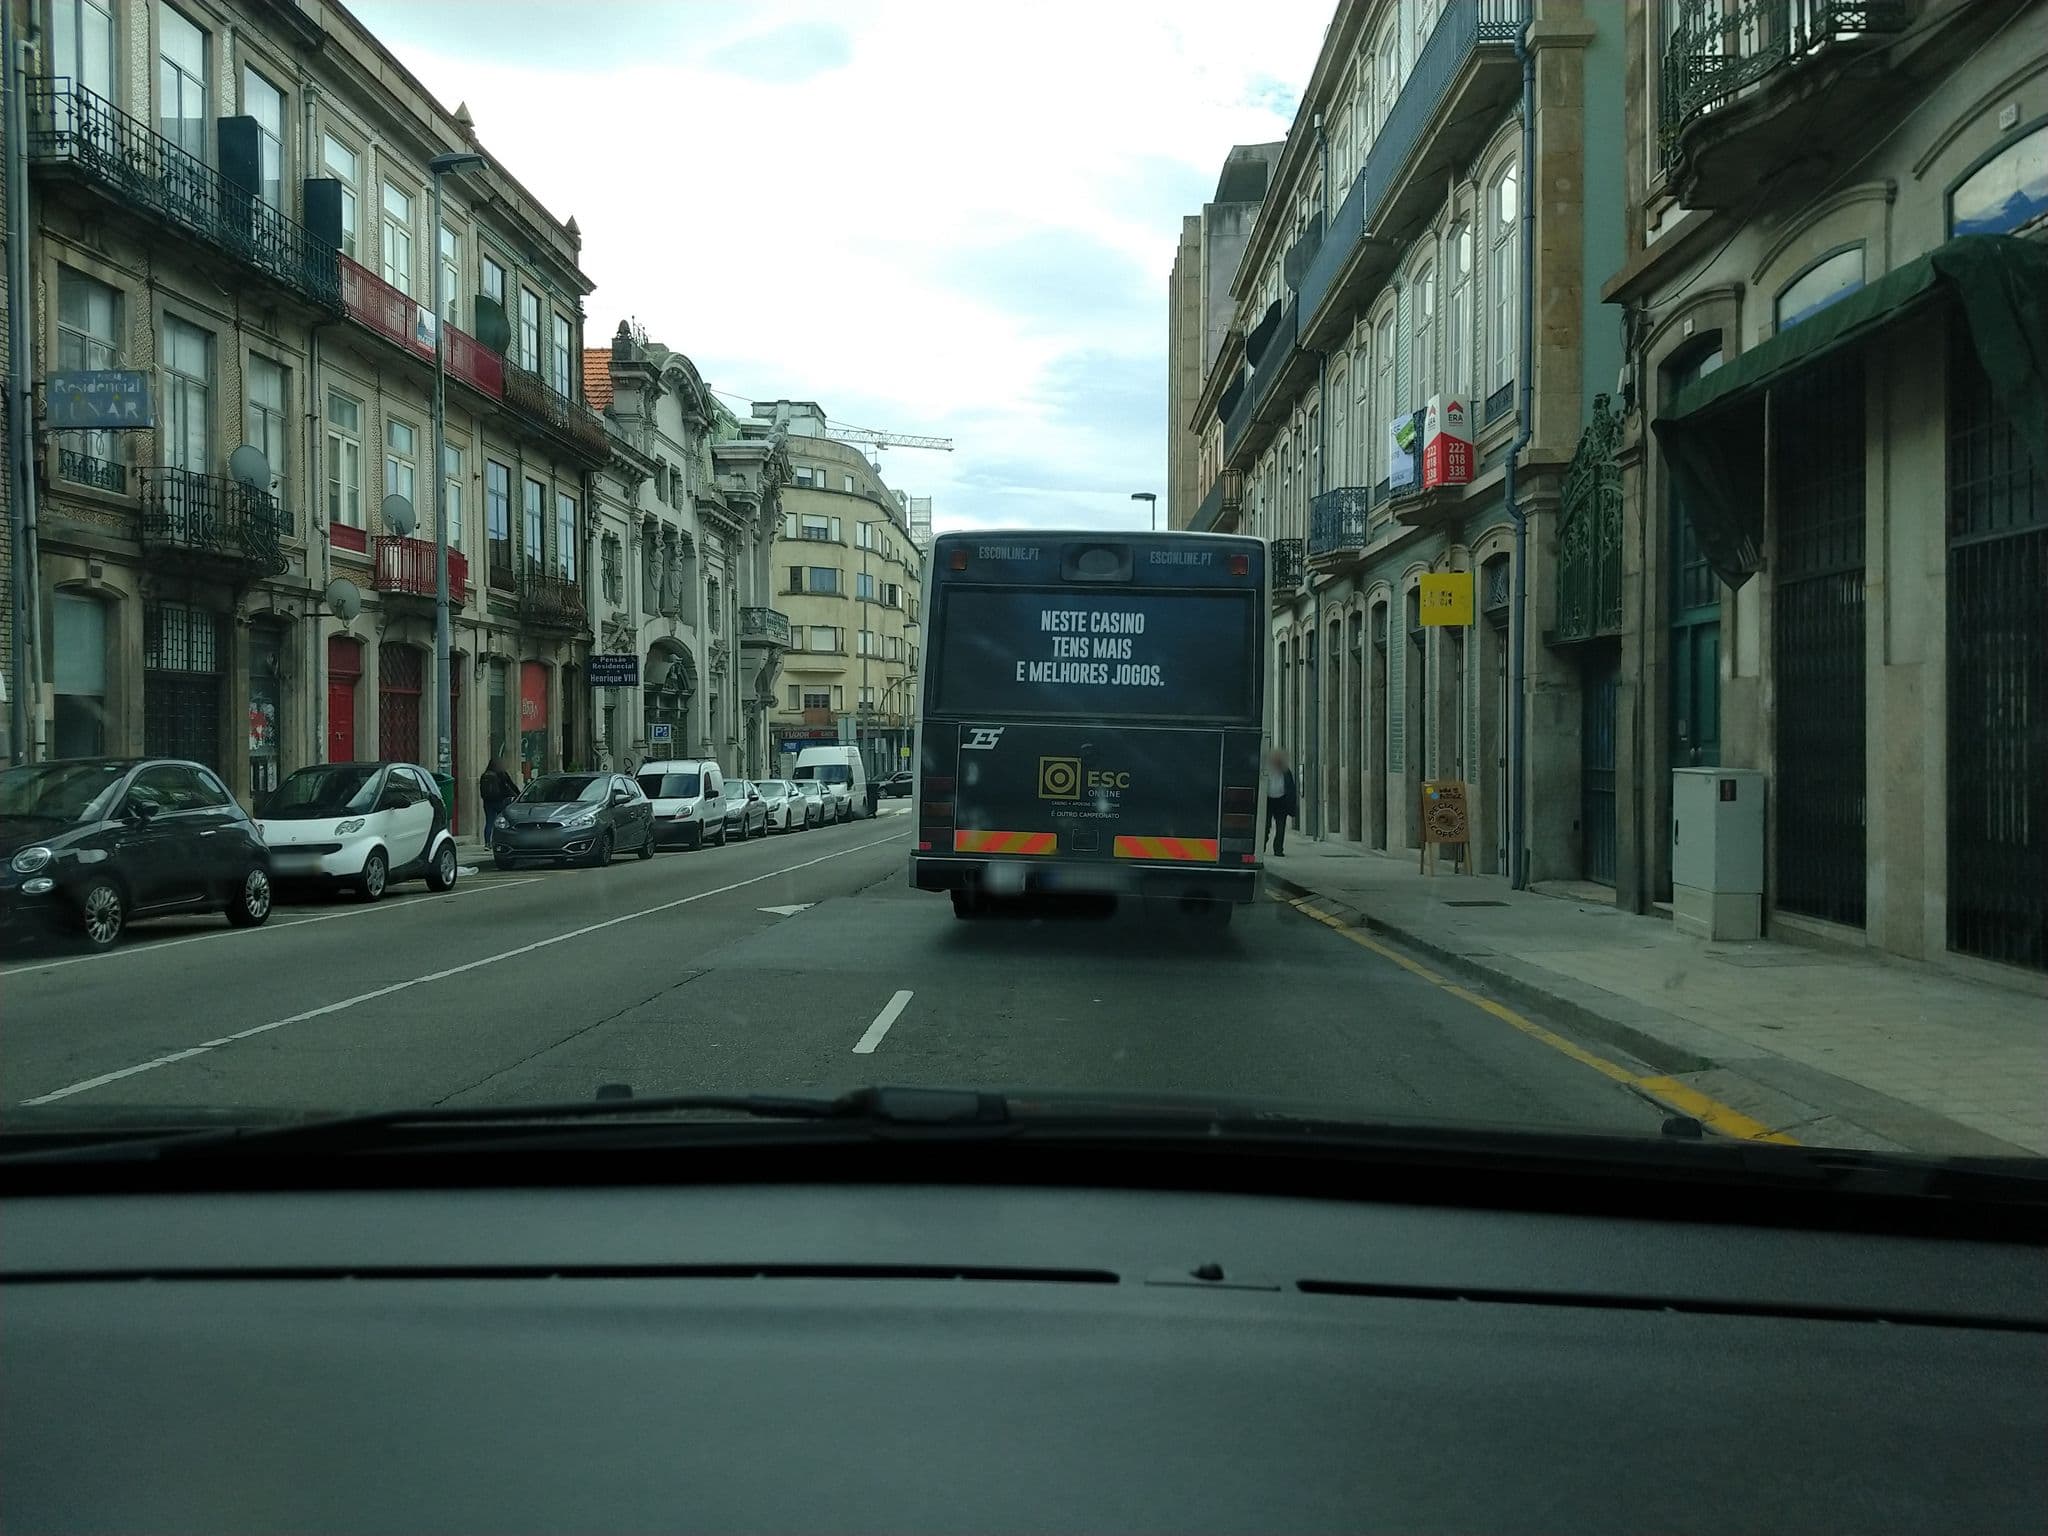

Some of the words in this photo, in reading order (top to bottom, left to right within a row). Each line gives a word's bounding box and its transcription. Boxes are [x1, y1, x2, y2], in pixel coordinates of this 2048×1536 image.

[55, 378, 140, 393] Residencial
[1448, 414, 1464, 422] ERA
[1448, 443, 1465, 454] 222
[1448, 454, 1466, 465] 018
[1449, 465, 1466, 477] 338
[979, 546, 1040, 561] ESCONLINE.PT
[1041, 610, 1087, 633] NESTE
[1090, 611, 1145, 634] CASINO
[1052, 636, 1089, 658] TENS
[1093, 638, 1132, 660] MAIS
[592, 662, 634, 670] Residencial
[590, 674, 622, 684] Henrique
[623, 674, 636, 682] VIII
[1016, 661, 1026, 682] E
[1029, 661, 1108, 685] MELHORES
[1111, 664, 1165, 686] JOGOS.
[655, 726, 663, 737] P
[1087, 770, 1130, 789] ESC
[1088, 789, 1121, 798] ONINE
[1079, 811, 1120, 819] CAMPEONATO
[1429, 803, 1464, 821] SPECIALTY
[1430, 825, 1464, 838] COFFEE
